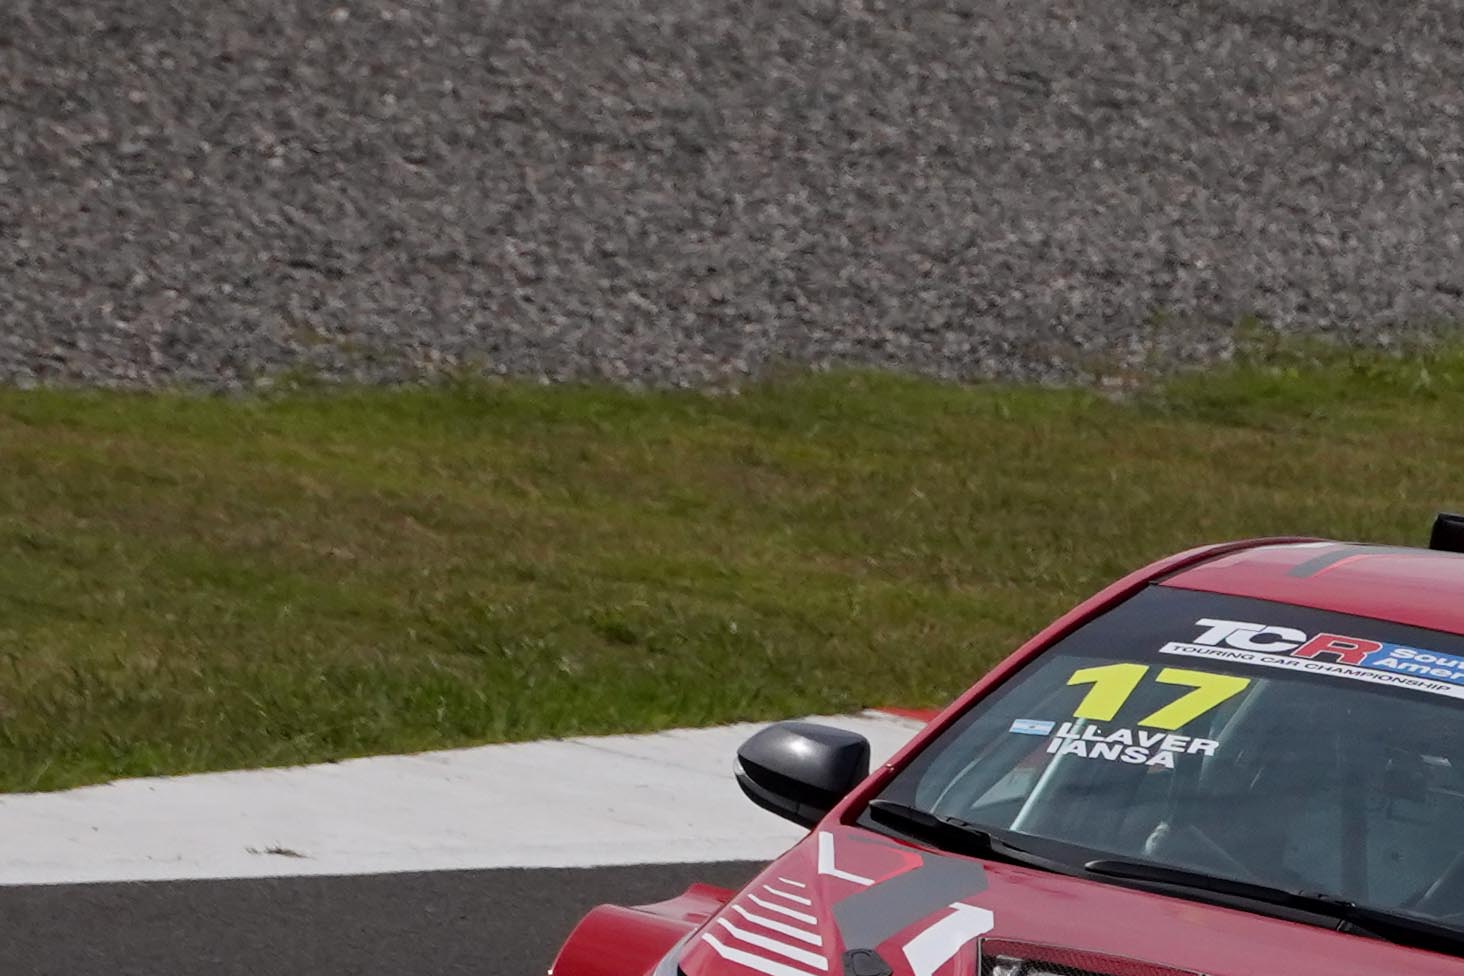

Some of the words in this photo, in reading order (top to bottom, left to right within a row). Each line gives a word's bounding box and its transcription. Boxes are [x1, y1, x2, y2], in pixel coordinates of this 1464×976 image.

[1195, 618, 1383, 665] TCR
[1173, 645, 1255, 660] TOURING
[1260, 656, 1300, 668] CAR
[1304, 663, 1452, 691] CHAMPIONSHIP
[1066, 663, 1251, 730] 17
[1046, 737, 1175, 768] IANSA
[1056, 722, 1219, 756] LLAVER
